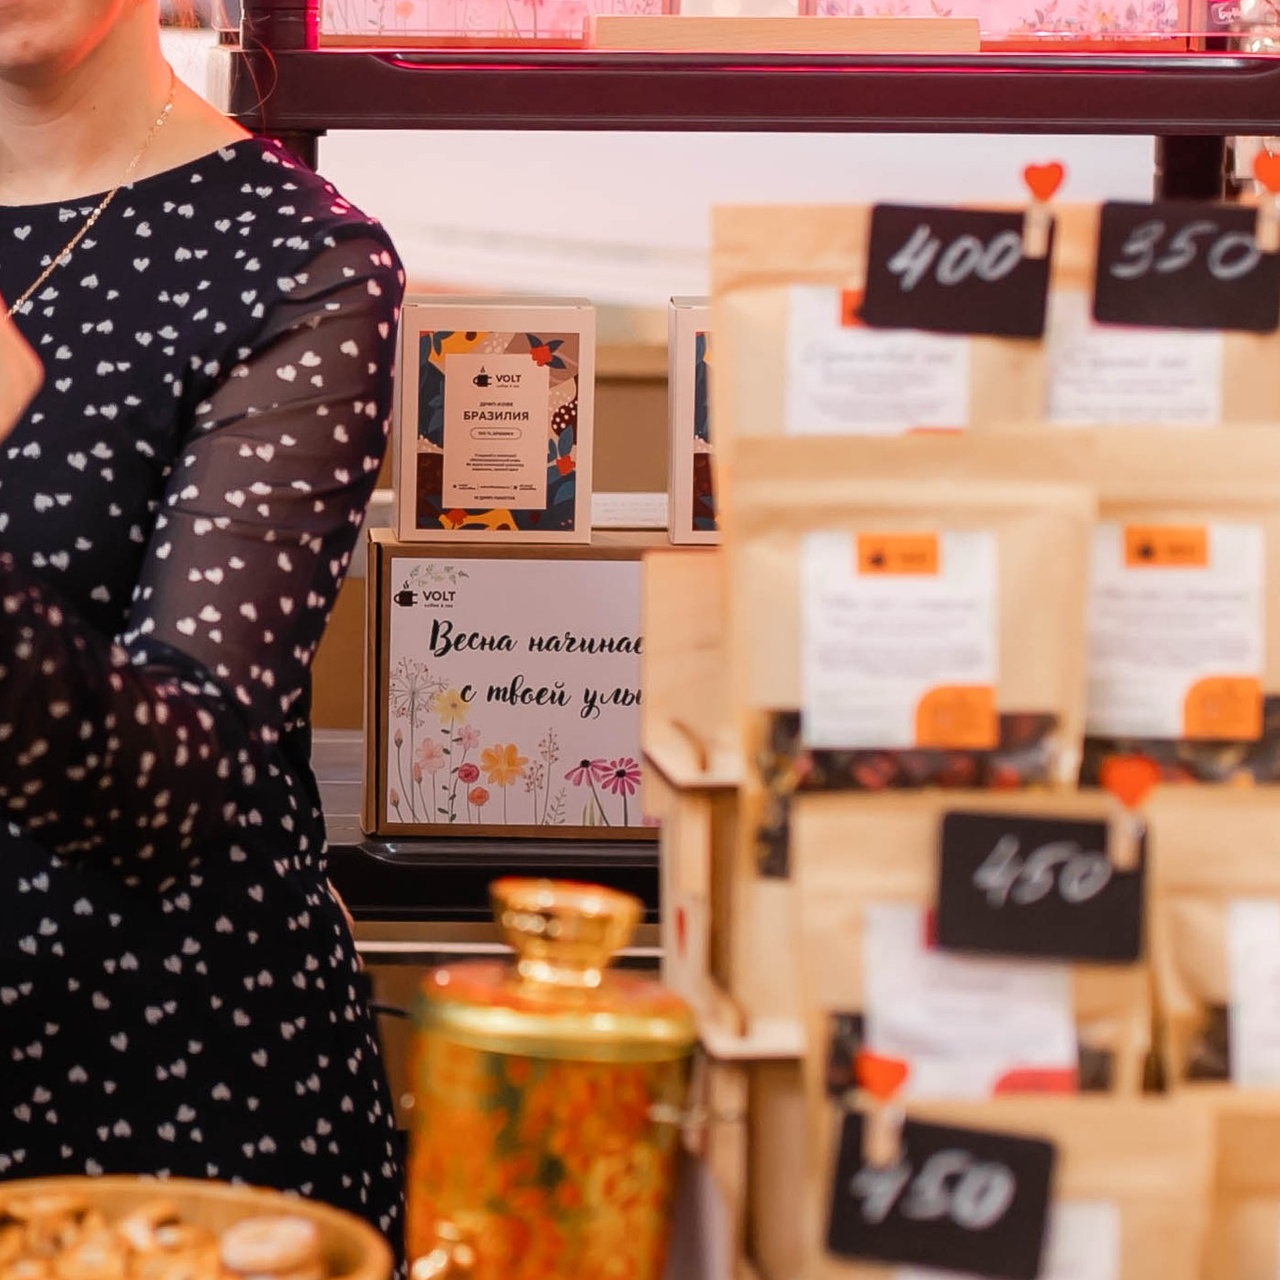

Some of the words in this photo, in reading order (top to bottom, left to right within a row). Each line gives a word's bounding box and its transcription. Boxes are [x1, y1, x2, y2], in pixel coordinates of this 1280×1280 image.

[885, 222, 1023, 292] 400
[1110, 220, 1261, 279] 350
[495, 374, 522, 383] VOLT
[463, 410, 529, 421] БРАЗИЛИЯ
[422, 590, 457, 602] VOLT
[428, 618, 518, 658] Весна
[460, 684, 477, 703] с
[486, 673, 572, 707] твоей
[972, 831, 1112, 910] 450
